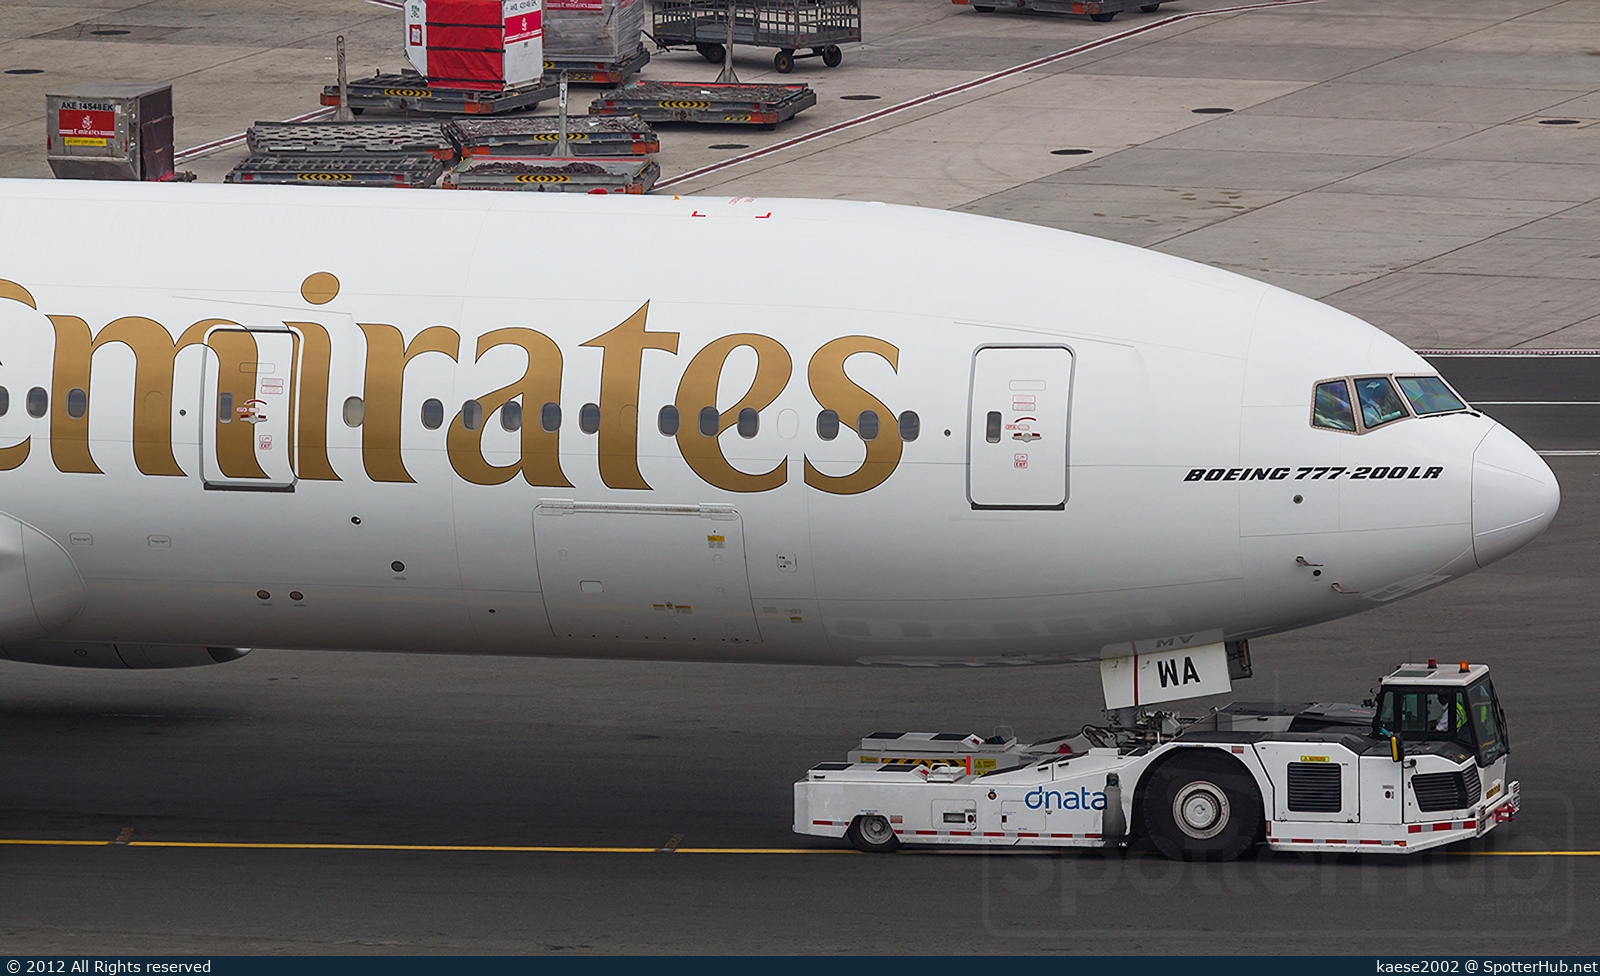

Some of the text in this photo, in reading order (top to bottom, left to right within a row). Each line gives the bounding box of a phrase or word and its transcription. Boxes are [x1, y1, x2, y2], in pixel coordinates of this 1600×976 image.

[61, 101, 77, 110] AKE
[0, 271, 903, 495] mirates
[1183, 466, 1444, 482] BOEING 777-200LR
[1157, 656, 1201, 688] WA
[1024, 786, 1108, 811] dnata
